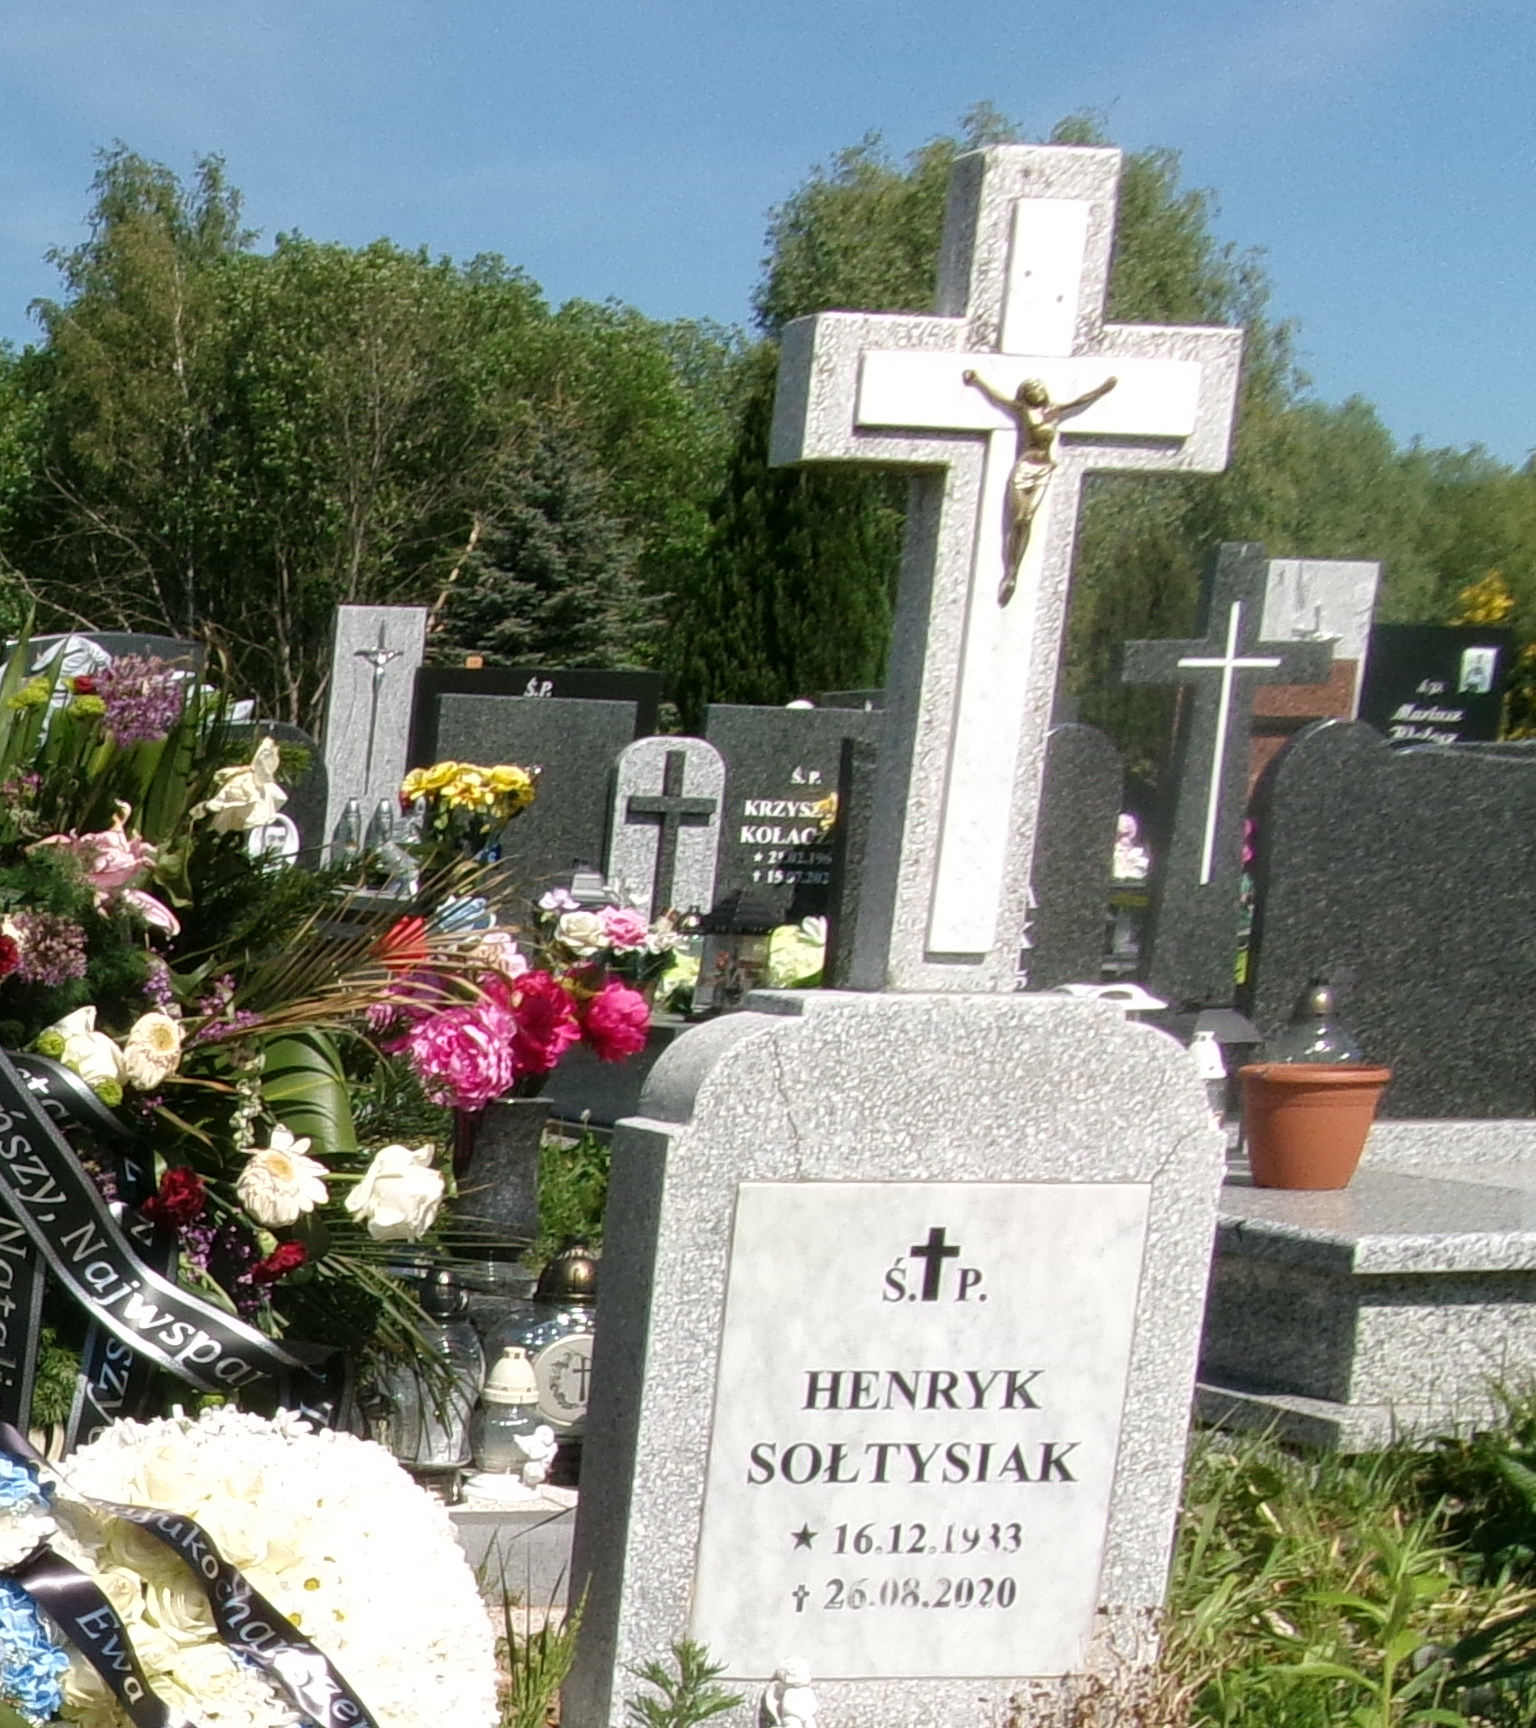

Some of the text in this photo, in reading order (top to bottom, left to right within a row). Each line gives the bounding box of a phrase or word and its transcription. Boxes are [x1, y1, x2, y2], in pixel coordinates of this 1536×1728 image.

[801, 1368, 1045, 1411] HENRYK
[745, 1440, 1082, 1487] SOŁTYSIAK
[831, 1520, 1023, 1556] 16.12.1933
[823, 1575, 1018, 1611] 26.08.2020
[75, 1604, 145, 1706] Ewa
